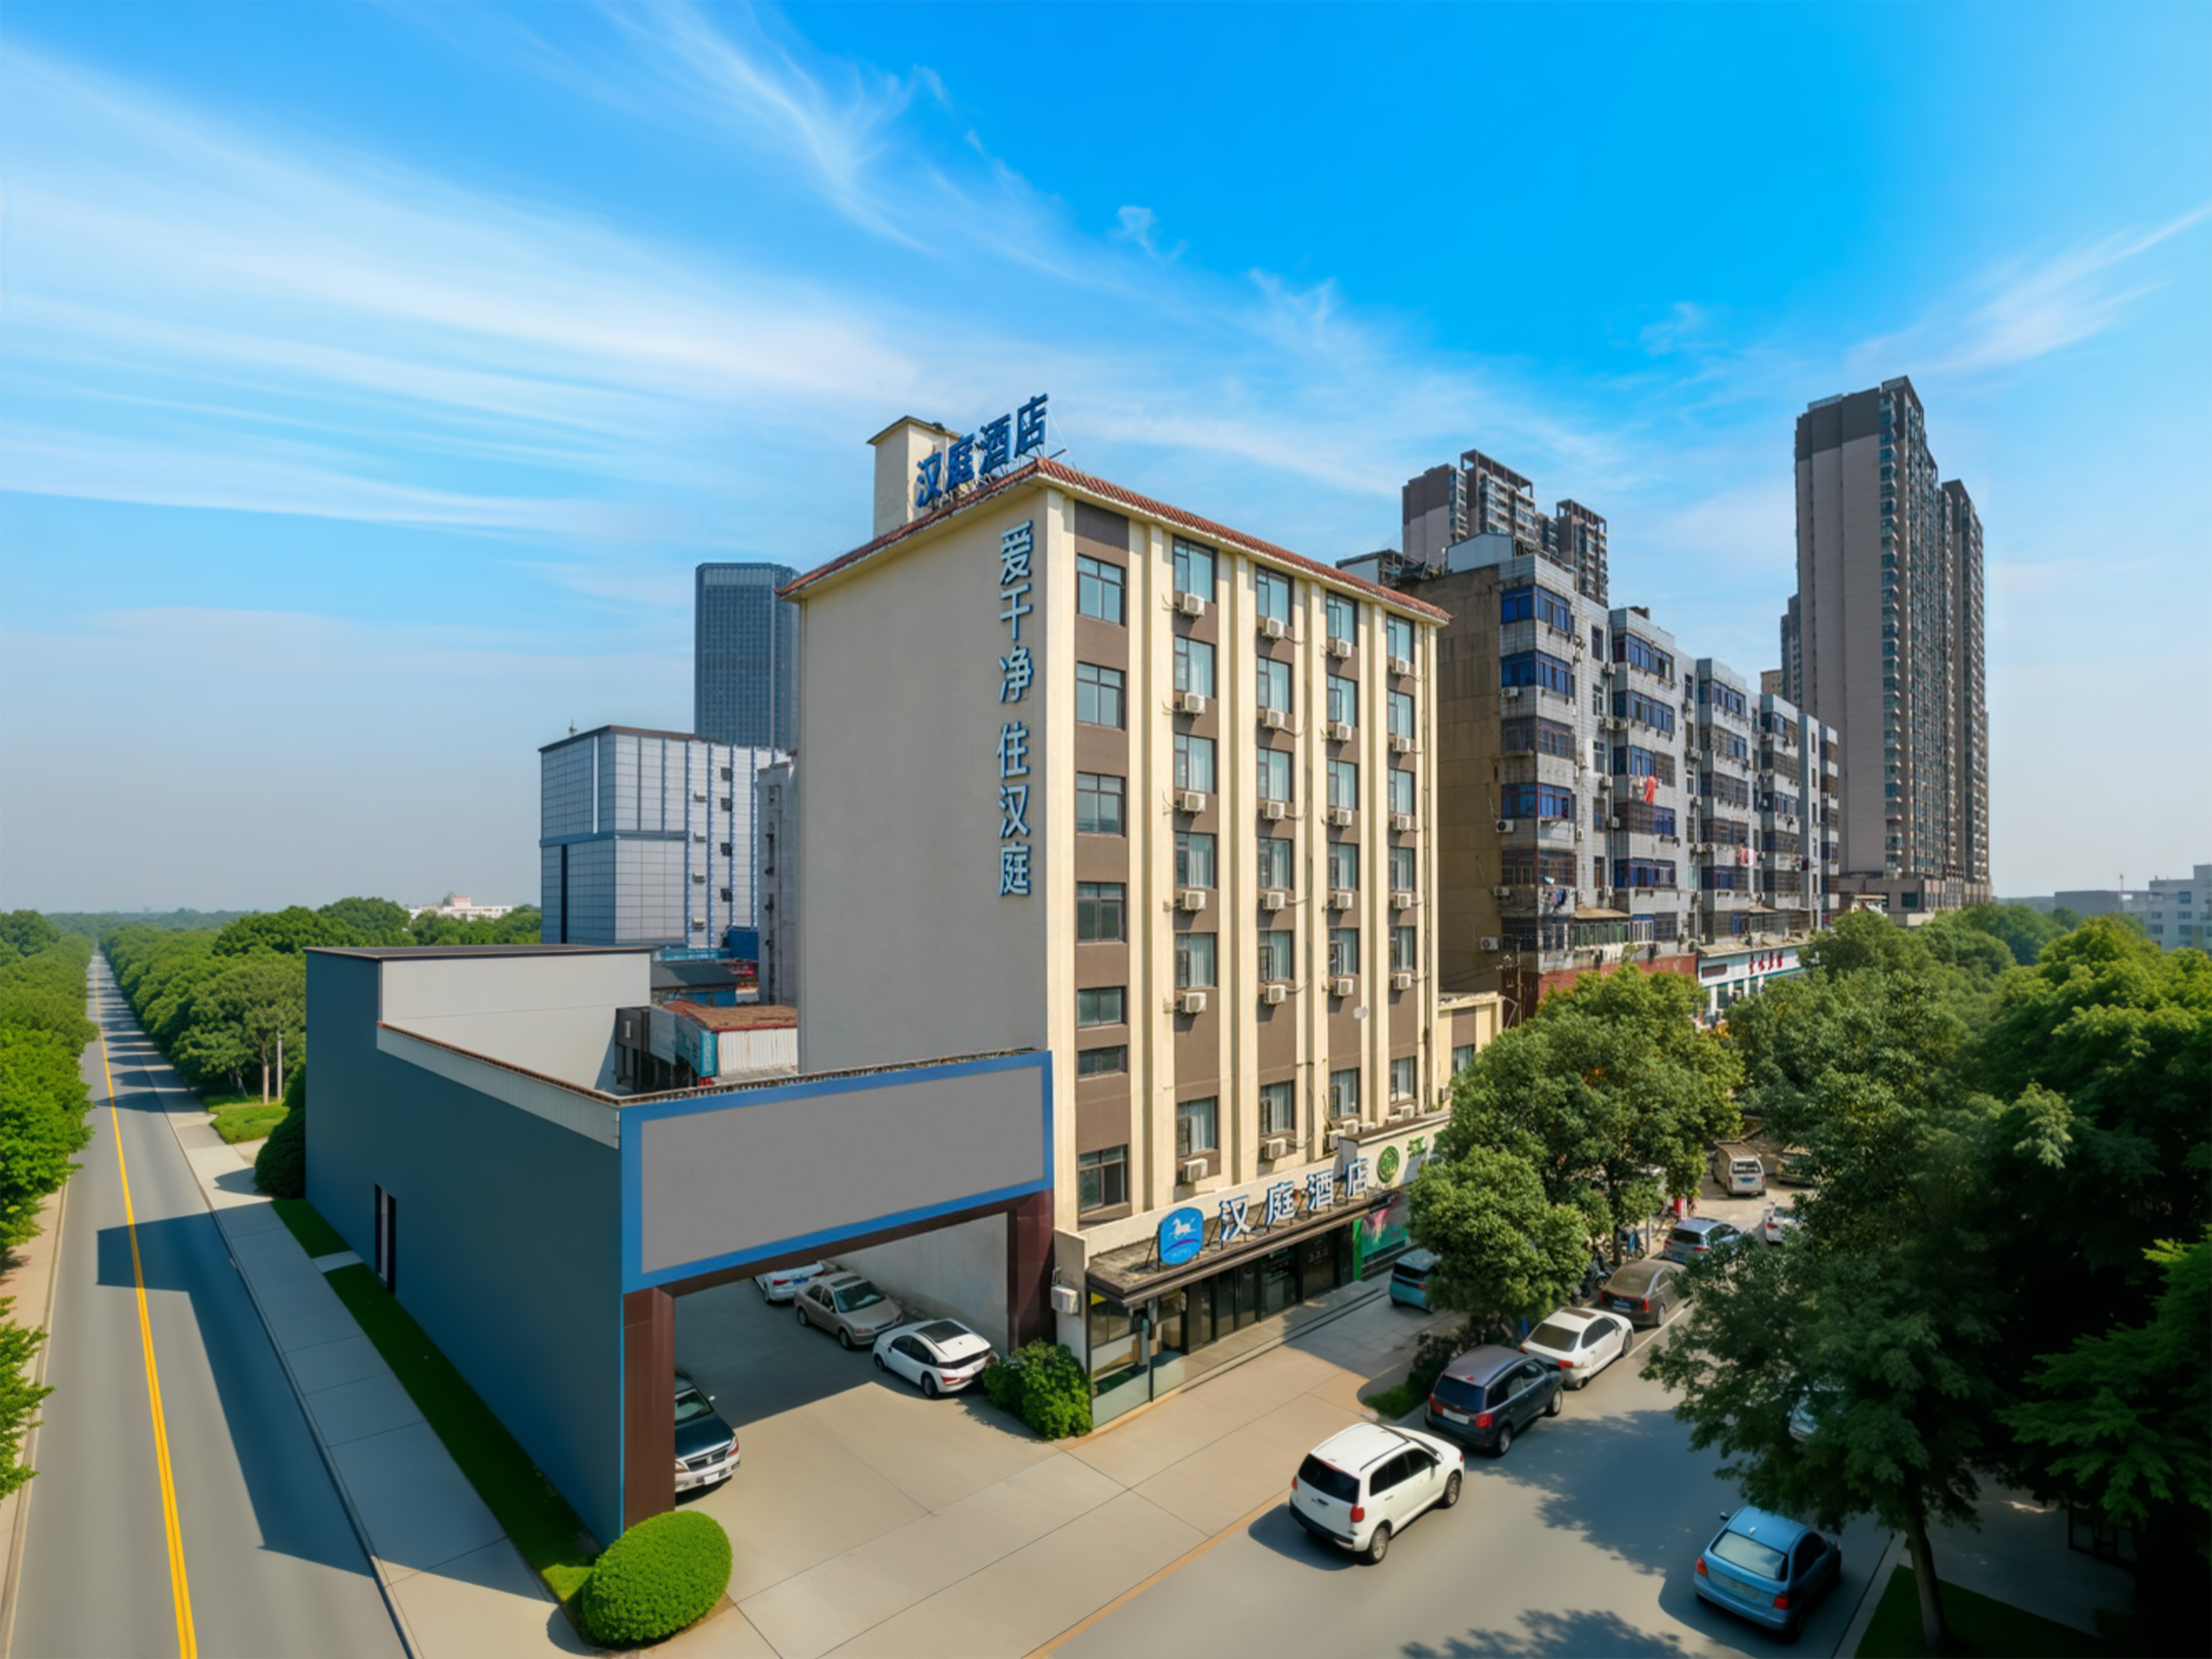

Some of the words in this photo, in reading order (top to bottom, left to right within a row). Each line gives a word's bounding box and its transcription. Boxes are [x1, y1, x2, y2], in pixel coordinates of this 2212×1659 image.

[917, 393, 1048, 508] 汉庭酒店
[999, 519, 1034, 703] 爱干净
[997, 720, 1032, 897] 住汉庭
[1218, 1158, 1368, 1241] 汉庭酒店
